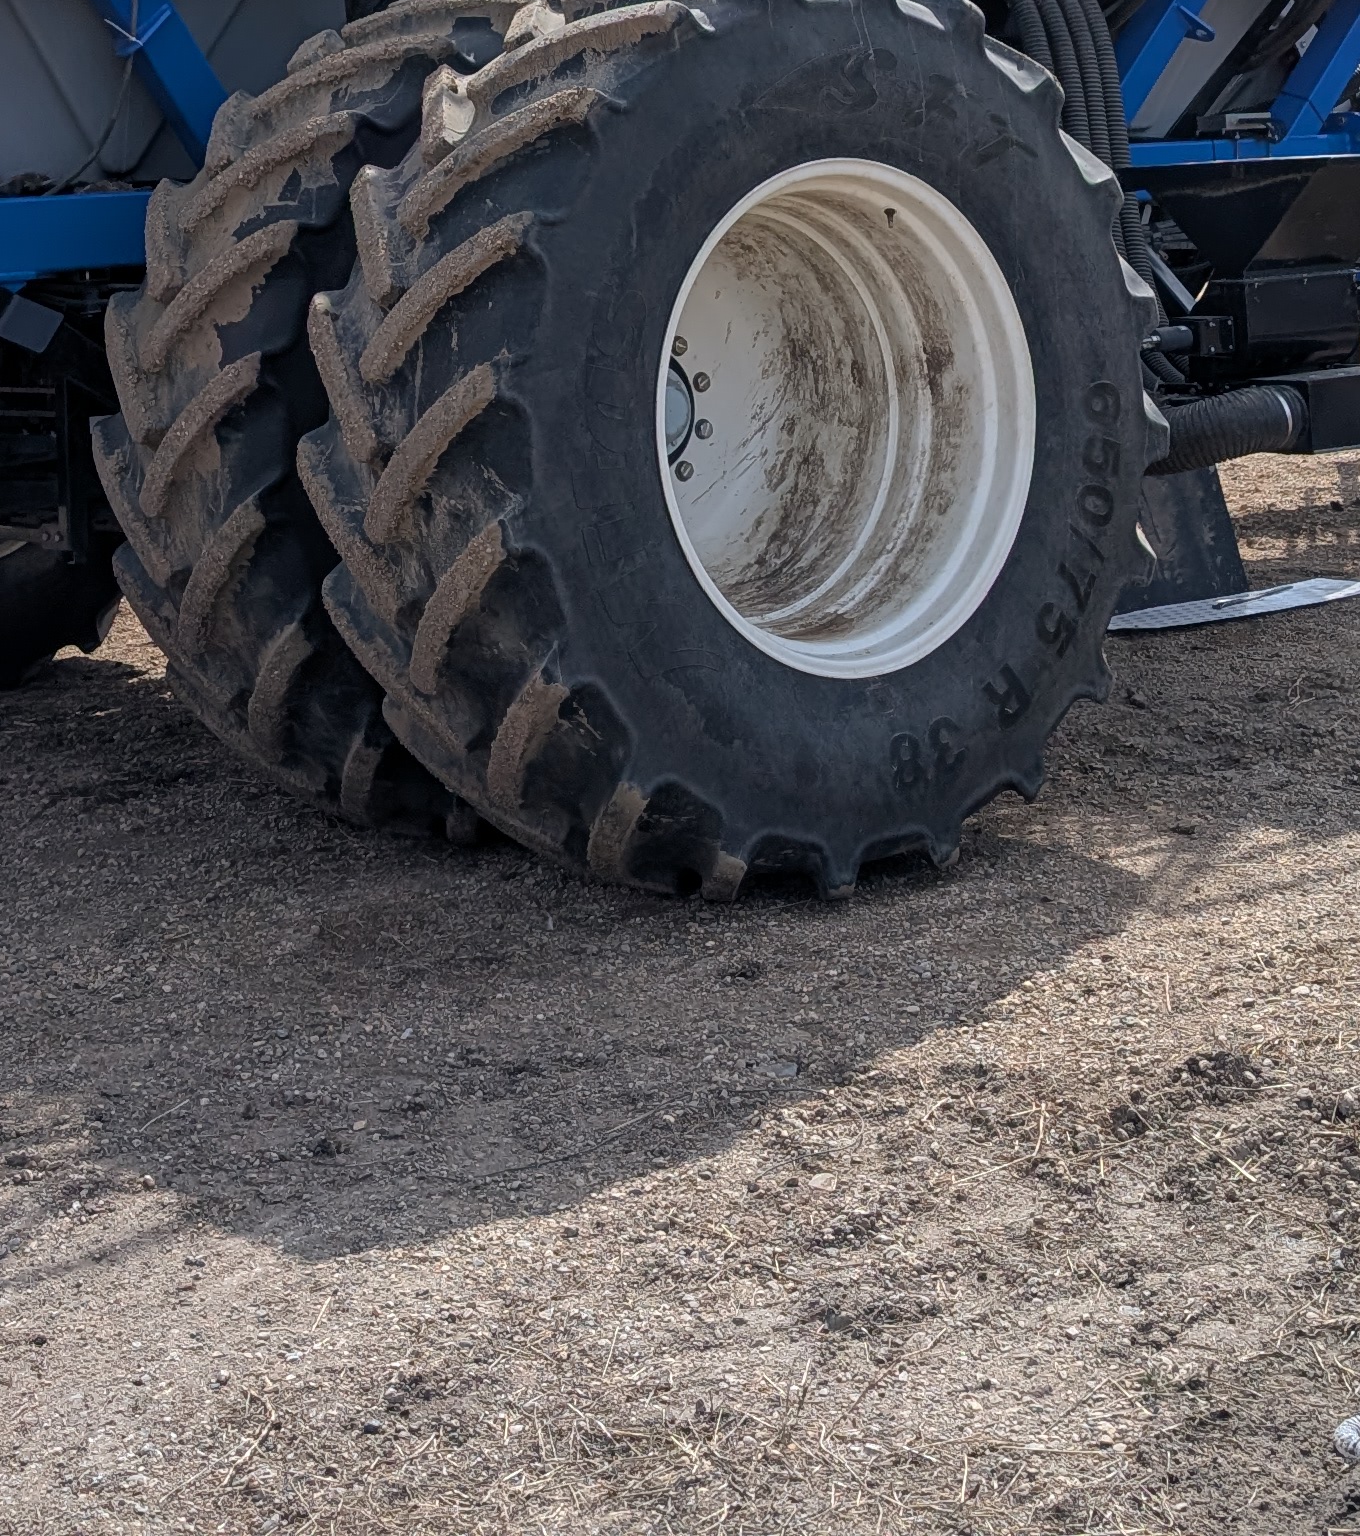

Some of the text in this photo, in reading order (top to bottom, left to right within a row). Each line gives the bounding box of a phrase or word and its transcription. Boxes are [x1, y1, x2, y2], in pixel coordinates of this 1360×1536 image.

[889, 379, 1124, 789] 650/75 R 38
